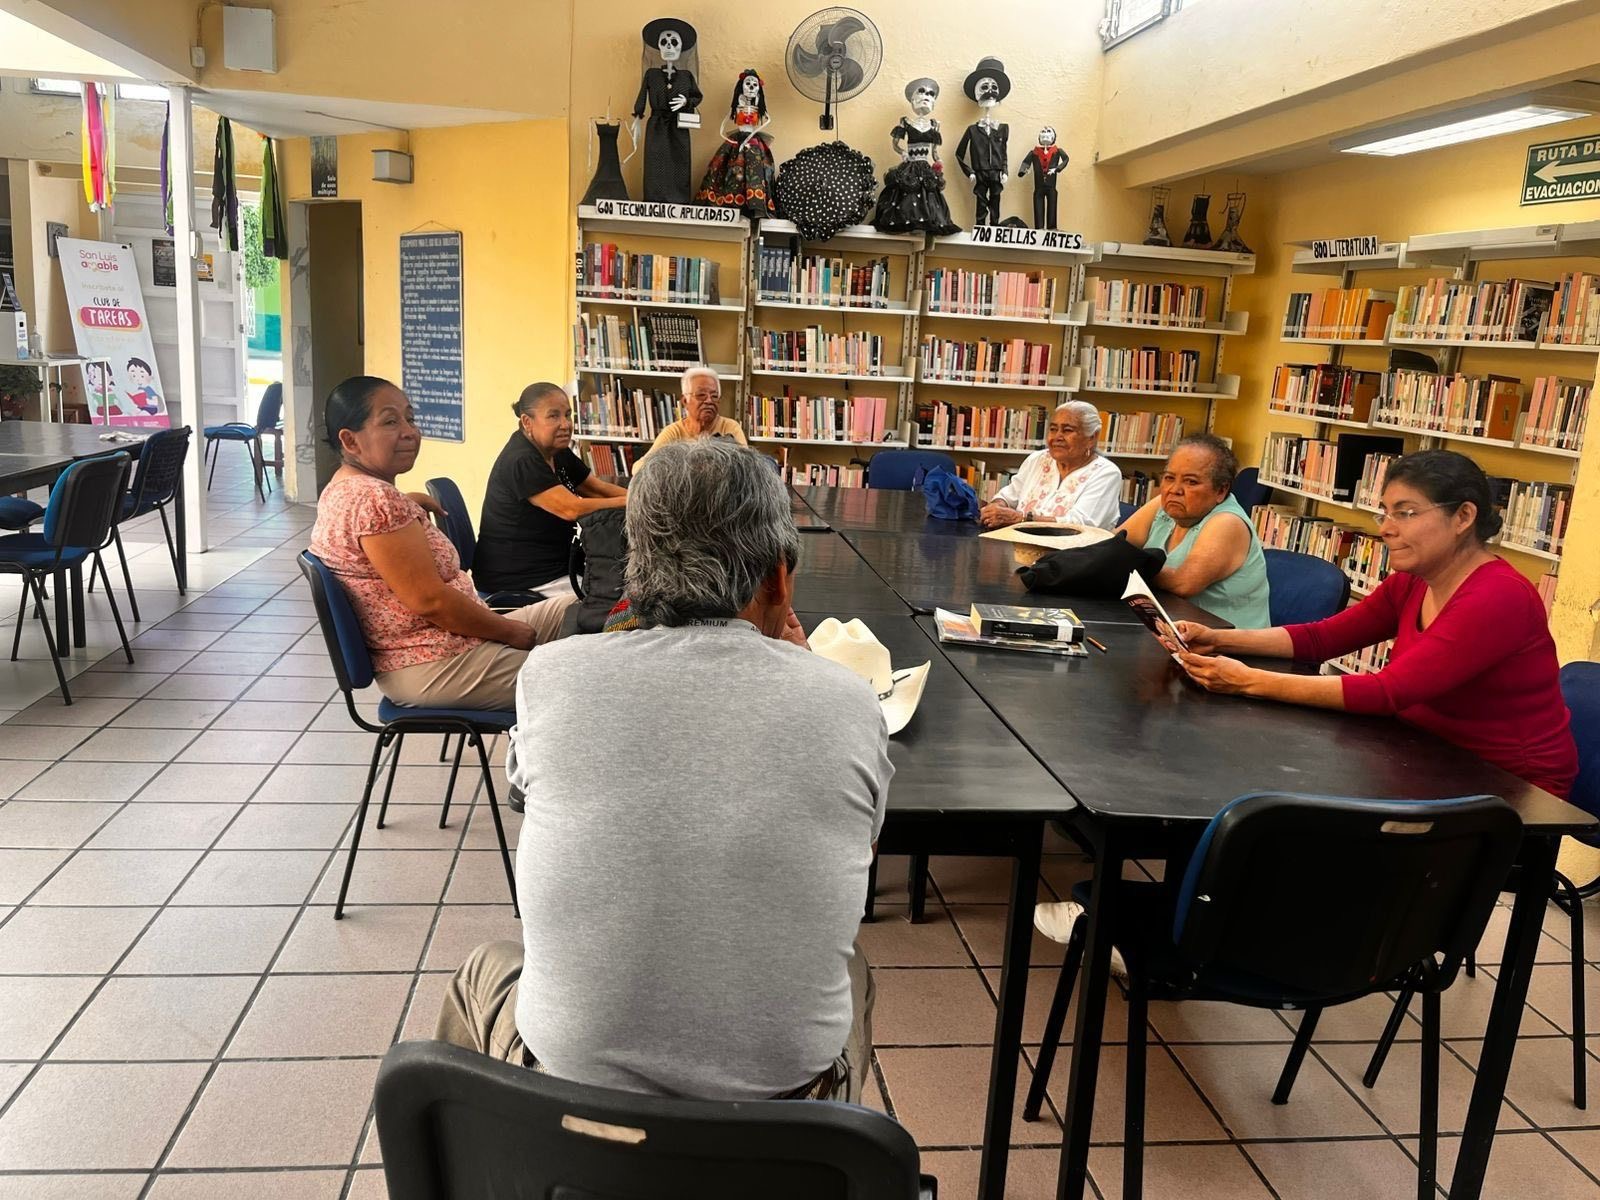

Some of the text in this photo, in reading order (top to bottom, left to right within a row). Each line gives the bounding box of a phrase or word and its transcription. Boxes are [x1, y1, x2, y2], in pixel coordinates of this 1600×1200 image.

[1536, 144, 1577, 162] RUTA
[972, 226, 1082, 250] 700 BELLAS ARTES
[1313, 236, 1377, 258] 800 LITERATURA
[79, 249, 118, 262] San Luis
[93, 296, 121, 308] CLUB DE
[88, 308, 133, 327] TAREAS
[686, 619, 728, 627] REMIUM
